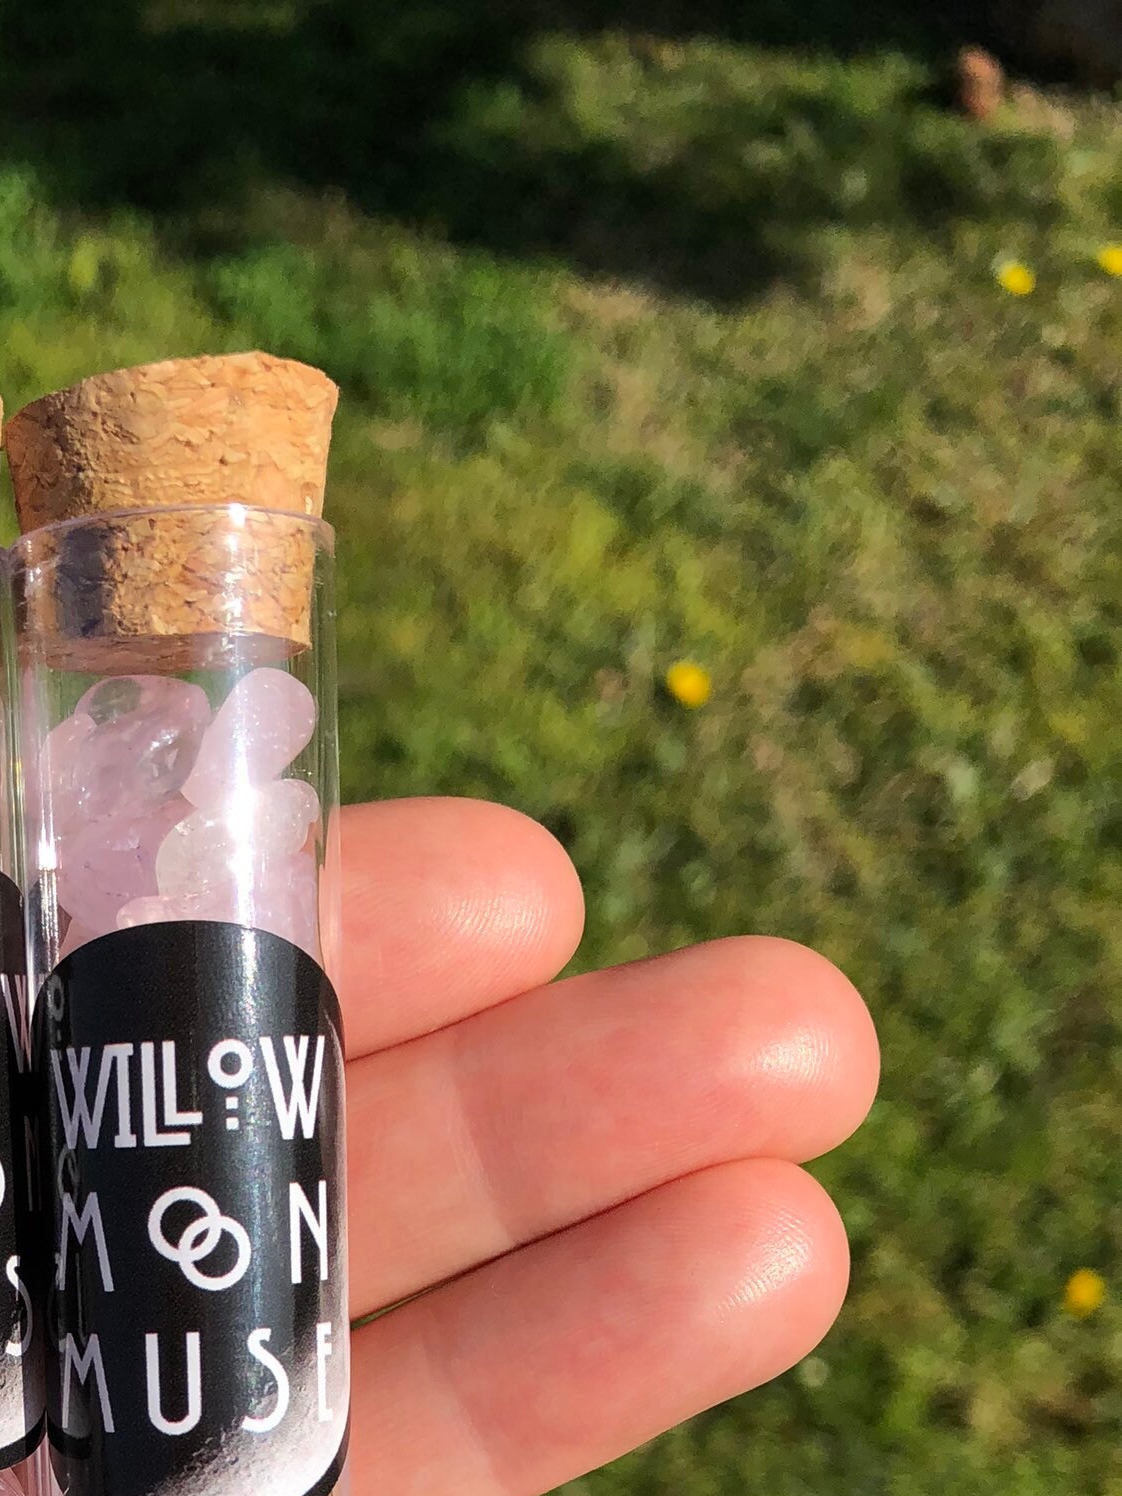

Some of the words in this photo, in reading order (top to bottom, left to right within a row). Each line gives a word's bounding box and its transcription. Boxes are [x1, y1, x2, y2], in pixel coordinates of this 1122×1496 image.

[51, 1036, 325, 1150] WILLOW
[58, 1181, 328, 1292] MOON
[62, 1327, 334, 1434] MUSE
